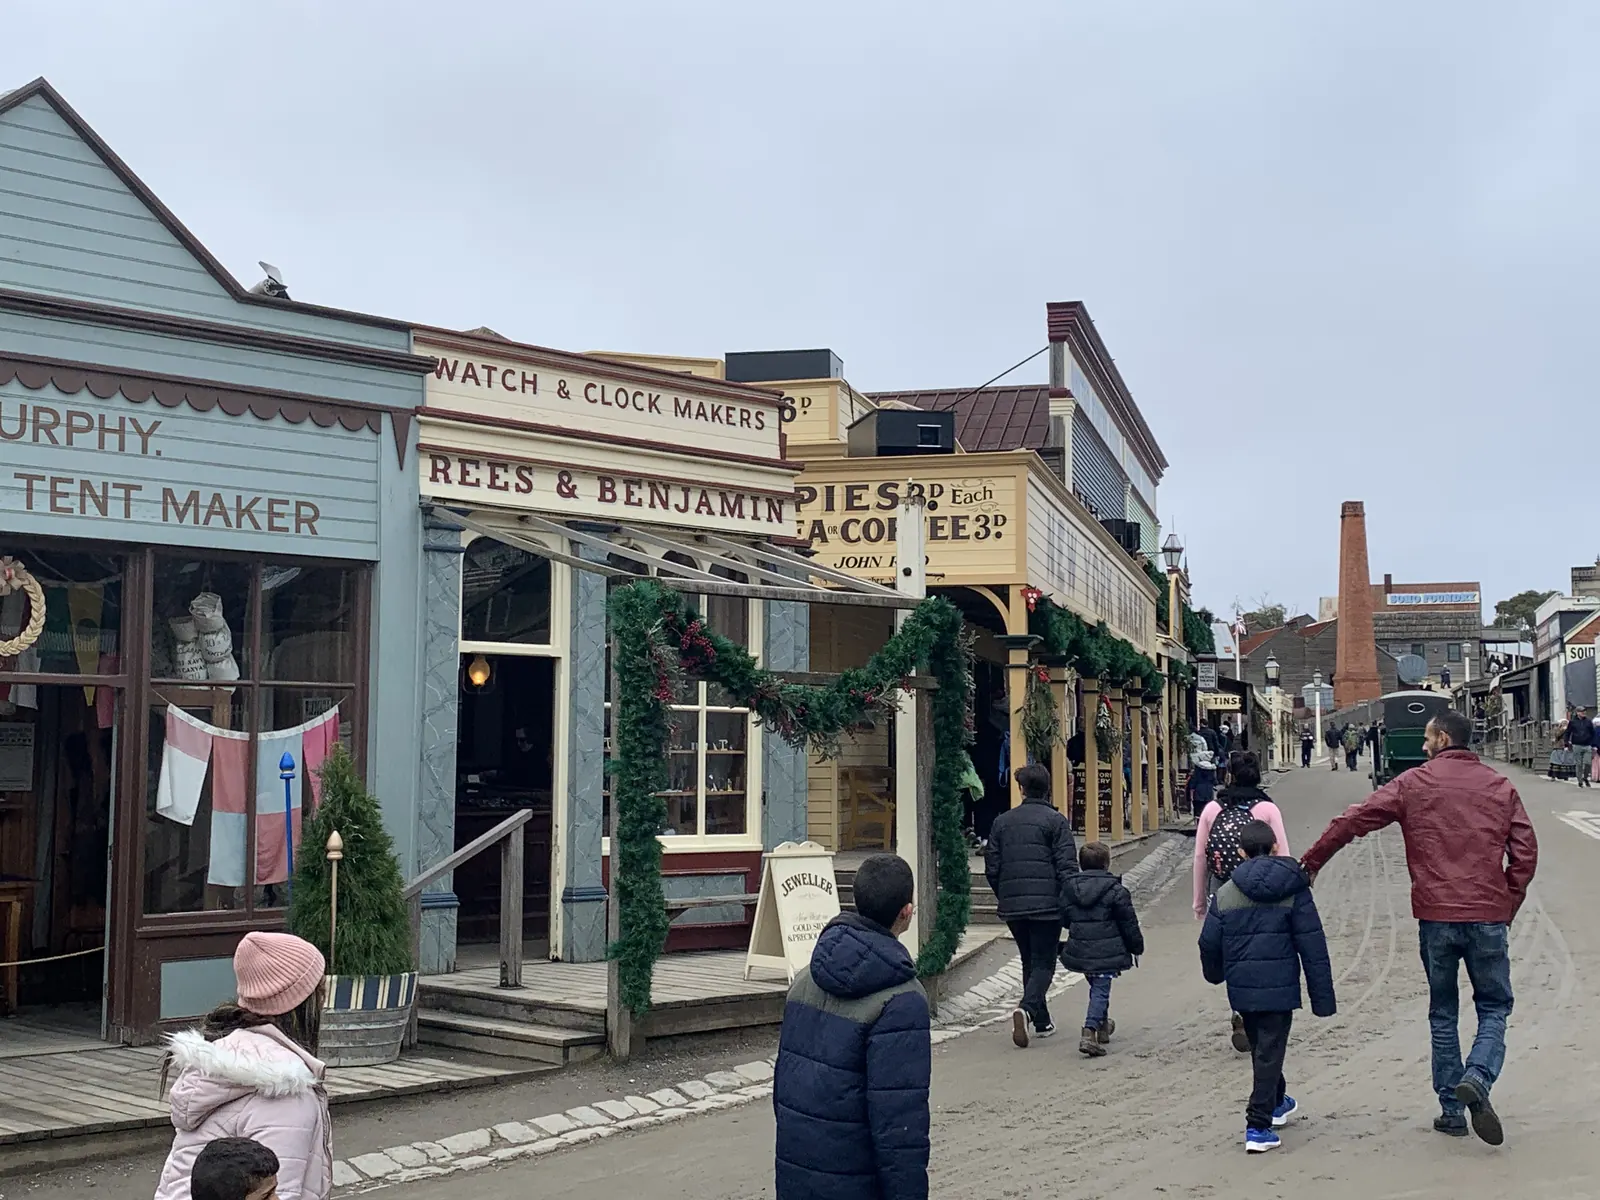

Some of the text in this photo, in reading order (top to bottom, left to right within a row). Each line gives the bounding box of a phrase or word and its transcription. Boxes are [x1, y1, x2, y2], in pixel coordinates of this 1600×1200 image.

[435, 358, 765, 430] WATCH & CLOCK MAKERS
[429, 454, 785, 524] REES & BENJAMIN
[794, 482, 900, 512] PIES
[951, 486, 993, 505] Each
[13, 472, 321, 536] TENT MAKER
[827, 525, 838, 534] OR
[833, 556, 883, 568] JOHN
[1390, 593, 1477, 603] SOHO FOUNDRY
[781, 873, 833, 897] JEWELLER
[793, 923, 811, 932] GOLD
